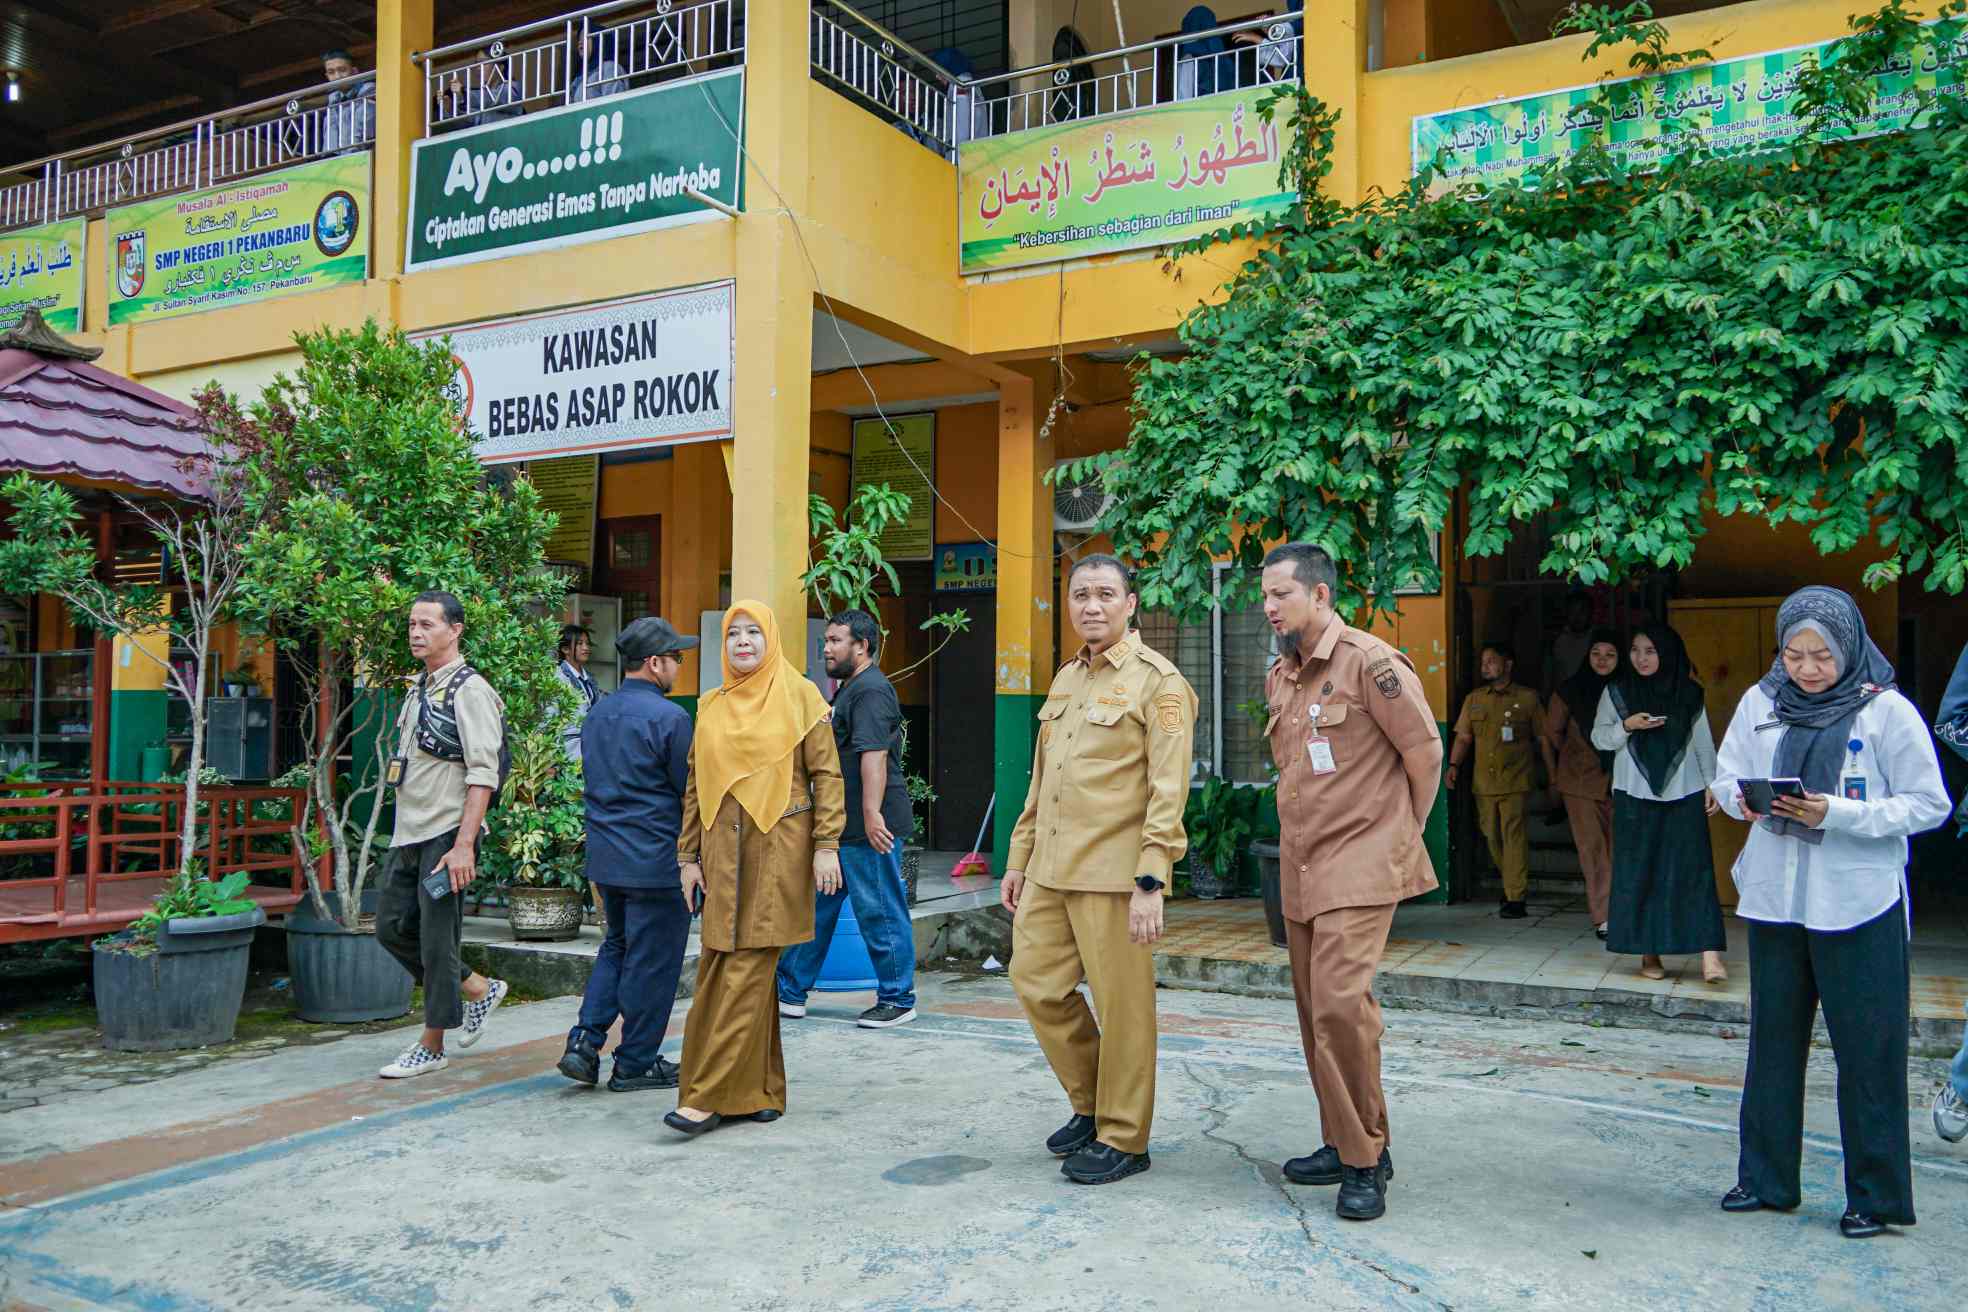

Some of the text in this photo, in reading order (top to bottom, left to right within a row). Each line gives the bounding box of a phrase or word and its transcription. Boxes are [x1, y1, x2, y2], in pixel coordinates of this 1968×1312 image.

[176, 199, 213, 217] Musala
[425, 161, 721, 250] Ciptakan Generasi Emas Tanpa Narkoba
[1098, 214, 1162, 241] sebagian
[1164, 206, 1192, 228] dari
[155, 222, 311, 271] SMP NEGERI 1 PEKANBARU
[211, 287, 236, 301] Kasim
[270, 274, 313, 289] Pekanbaru
[543, 319, 657, 374] KAWASAN
[488, 368, 720, 438] BEBAS ASAP ROKOK
